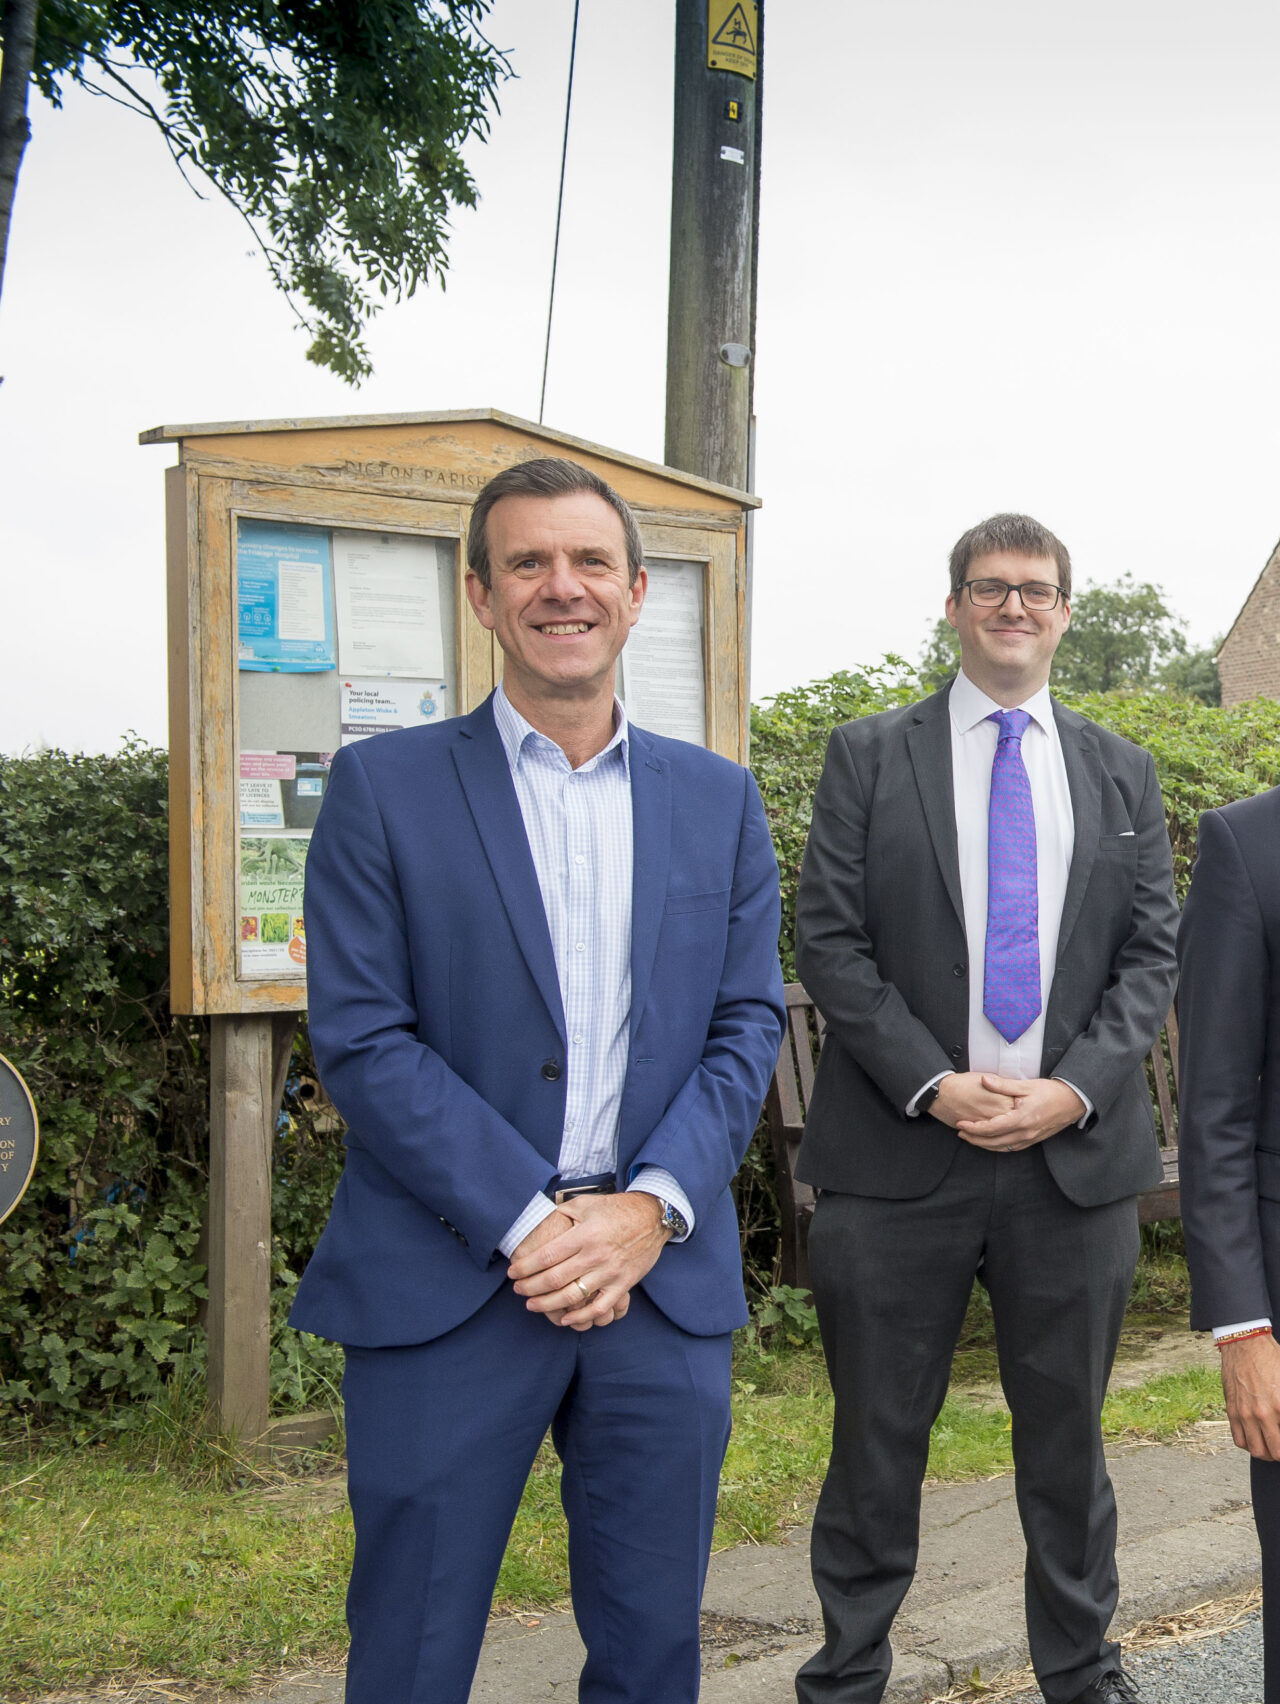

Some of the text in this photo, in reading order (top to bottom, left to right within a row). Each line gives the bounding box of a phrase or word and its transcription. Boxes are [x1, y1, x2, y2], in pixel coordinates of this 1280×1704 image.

[424, 468, 487, 487] PARISH
[348, 697, 374, 705] policing
[0, 1151, 14, 1160] OF
